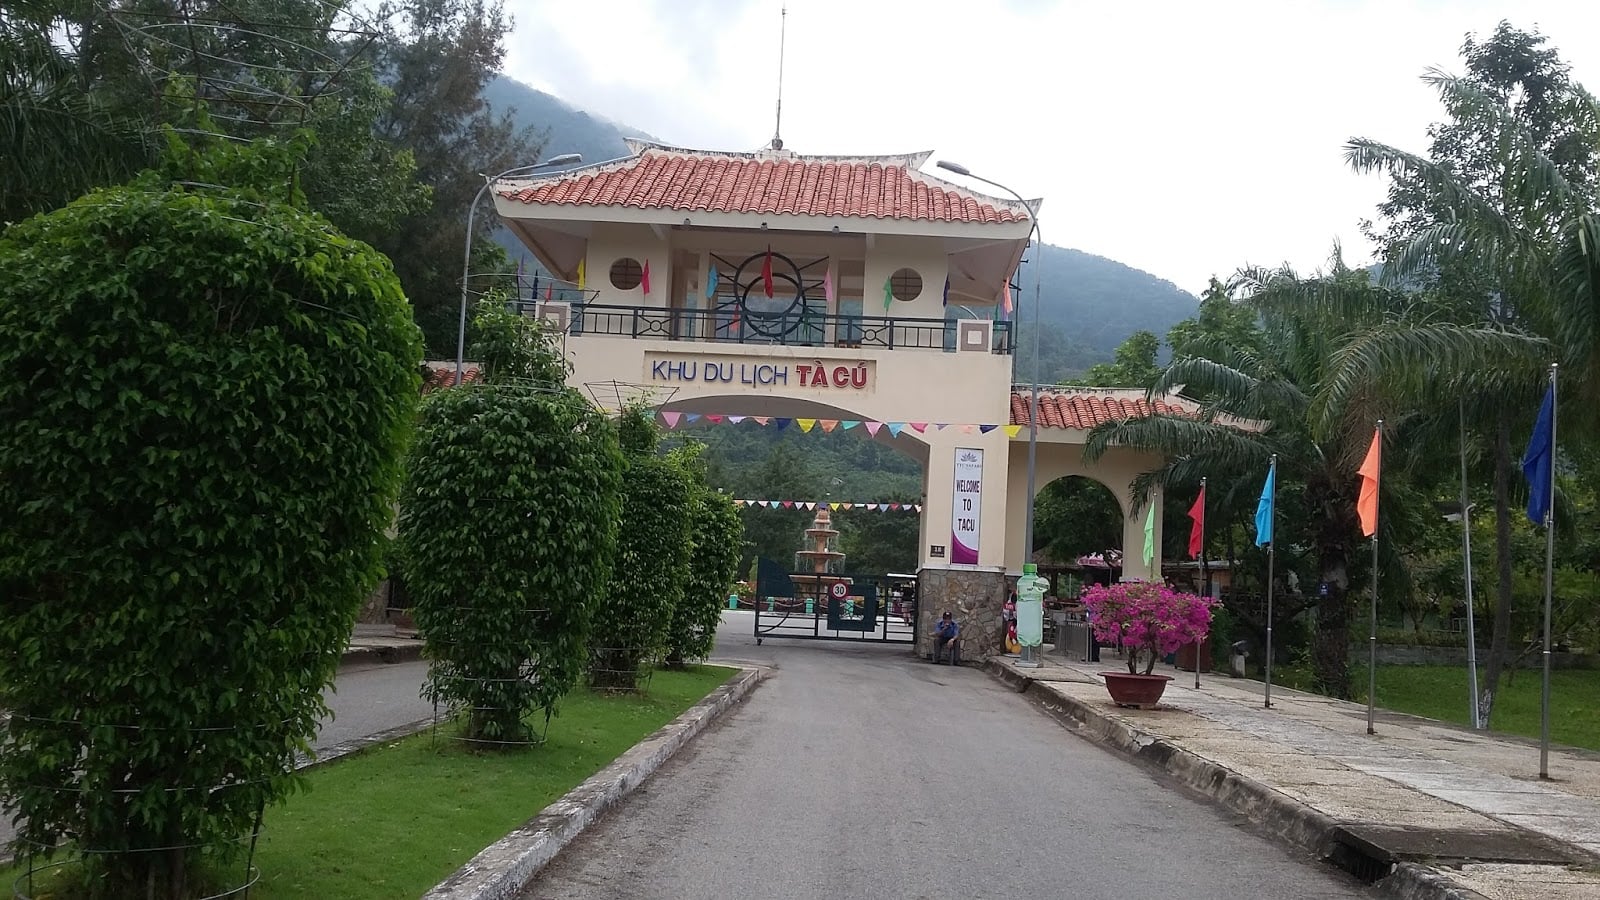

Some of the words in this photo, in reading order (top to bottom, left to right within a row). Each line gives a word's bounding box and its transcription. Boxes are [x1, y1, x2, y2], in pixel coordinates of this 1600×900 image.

[652, 360, 697, 381] KHU
[704, 362, 733, 383] DU
[741, 364, 787, 388] LỊCH
[796, 359, 829, 387] TÀ
[832, 361, 867, 389] CÚ
[956, 480, 980, 493] WELCOME
[963, 498, 972, 511] TO
[958, 518, 975, 532] TACU
[835, 585, 844, 595] 30
